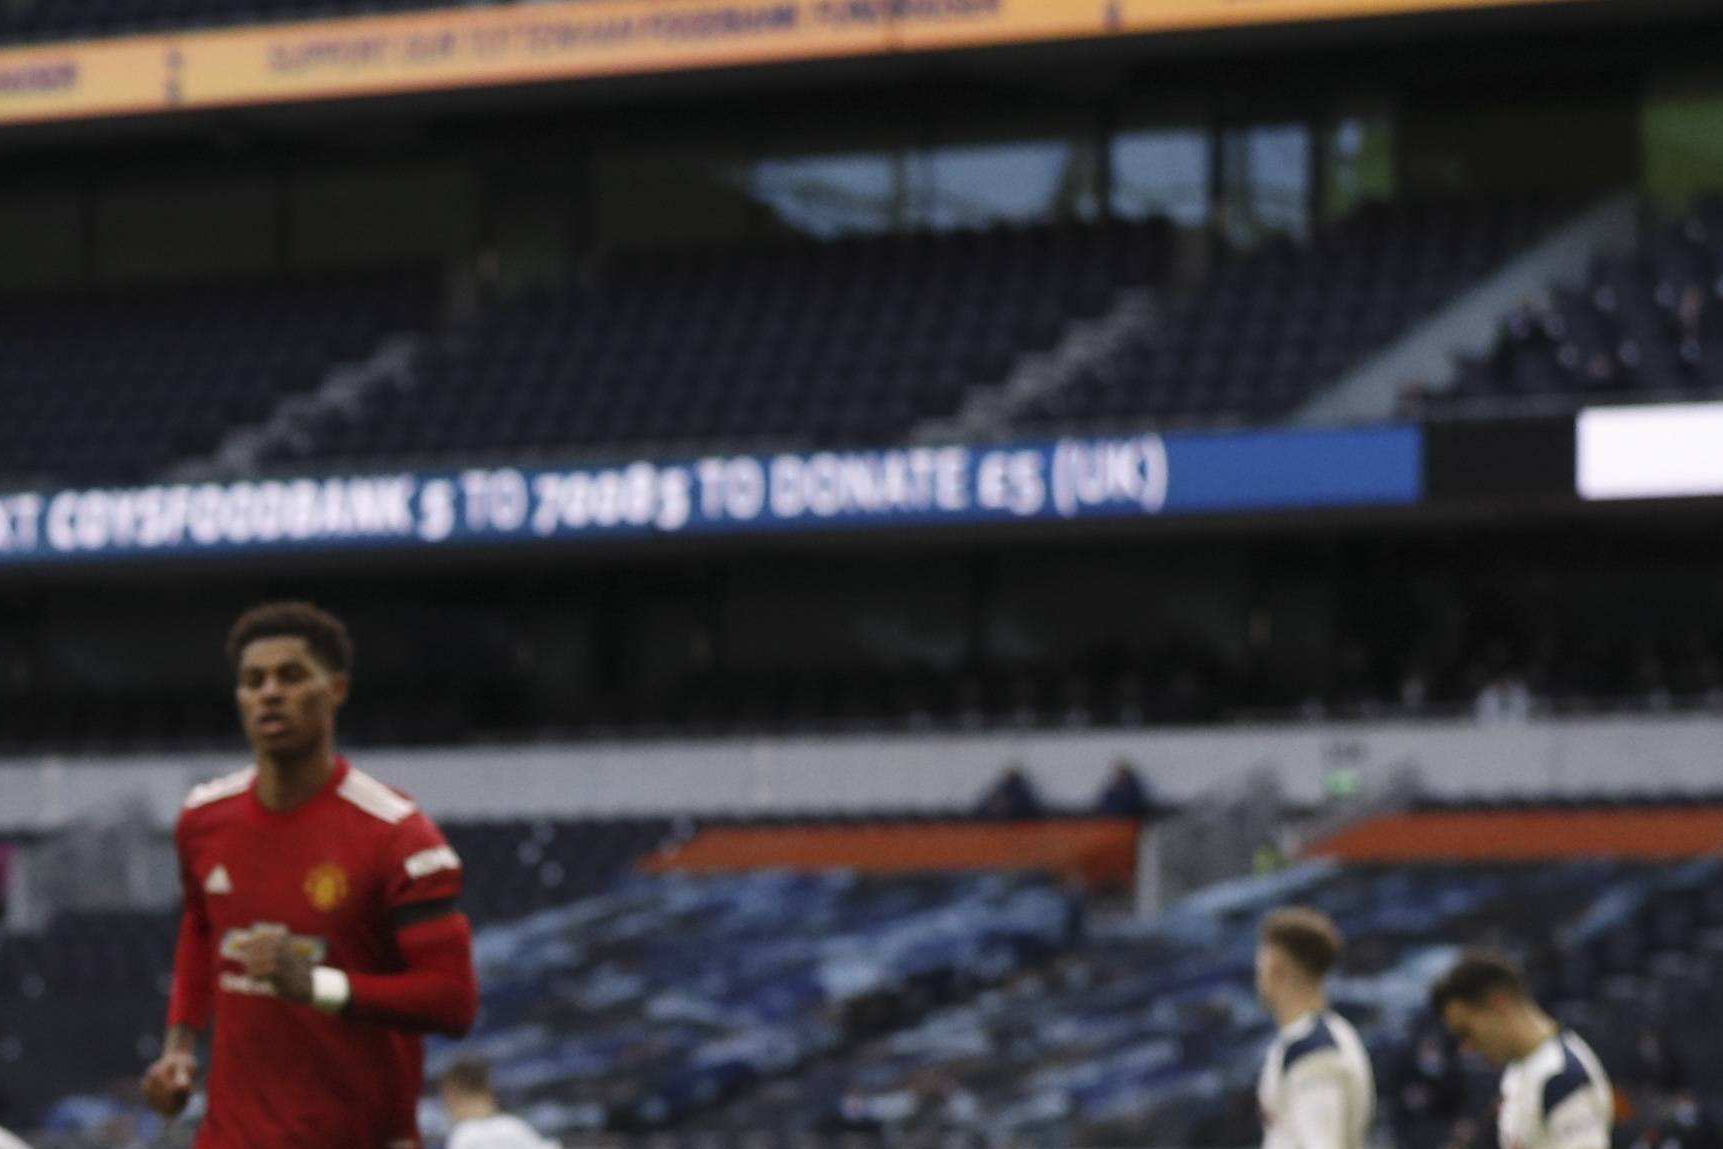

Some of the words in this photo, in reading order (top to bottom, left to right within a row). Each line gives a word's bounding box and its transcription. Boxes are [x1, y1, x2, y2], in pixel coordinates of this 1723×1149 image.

[459, 466, 527, 531] TO
[695, 455, 765, 520] TO
[769, 445, 971, 518] DONATE
[1050, 432, 1168, 518] (UK)
